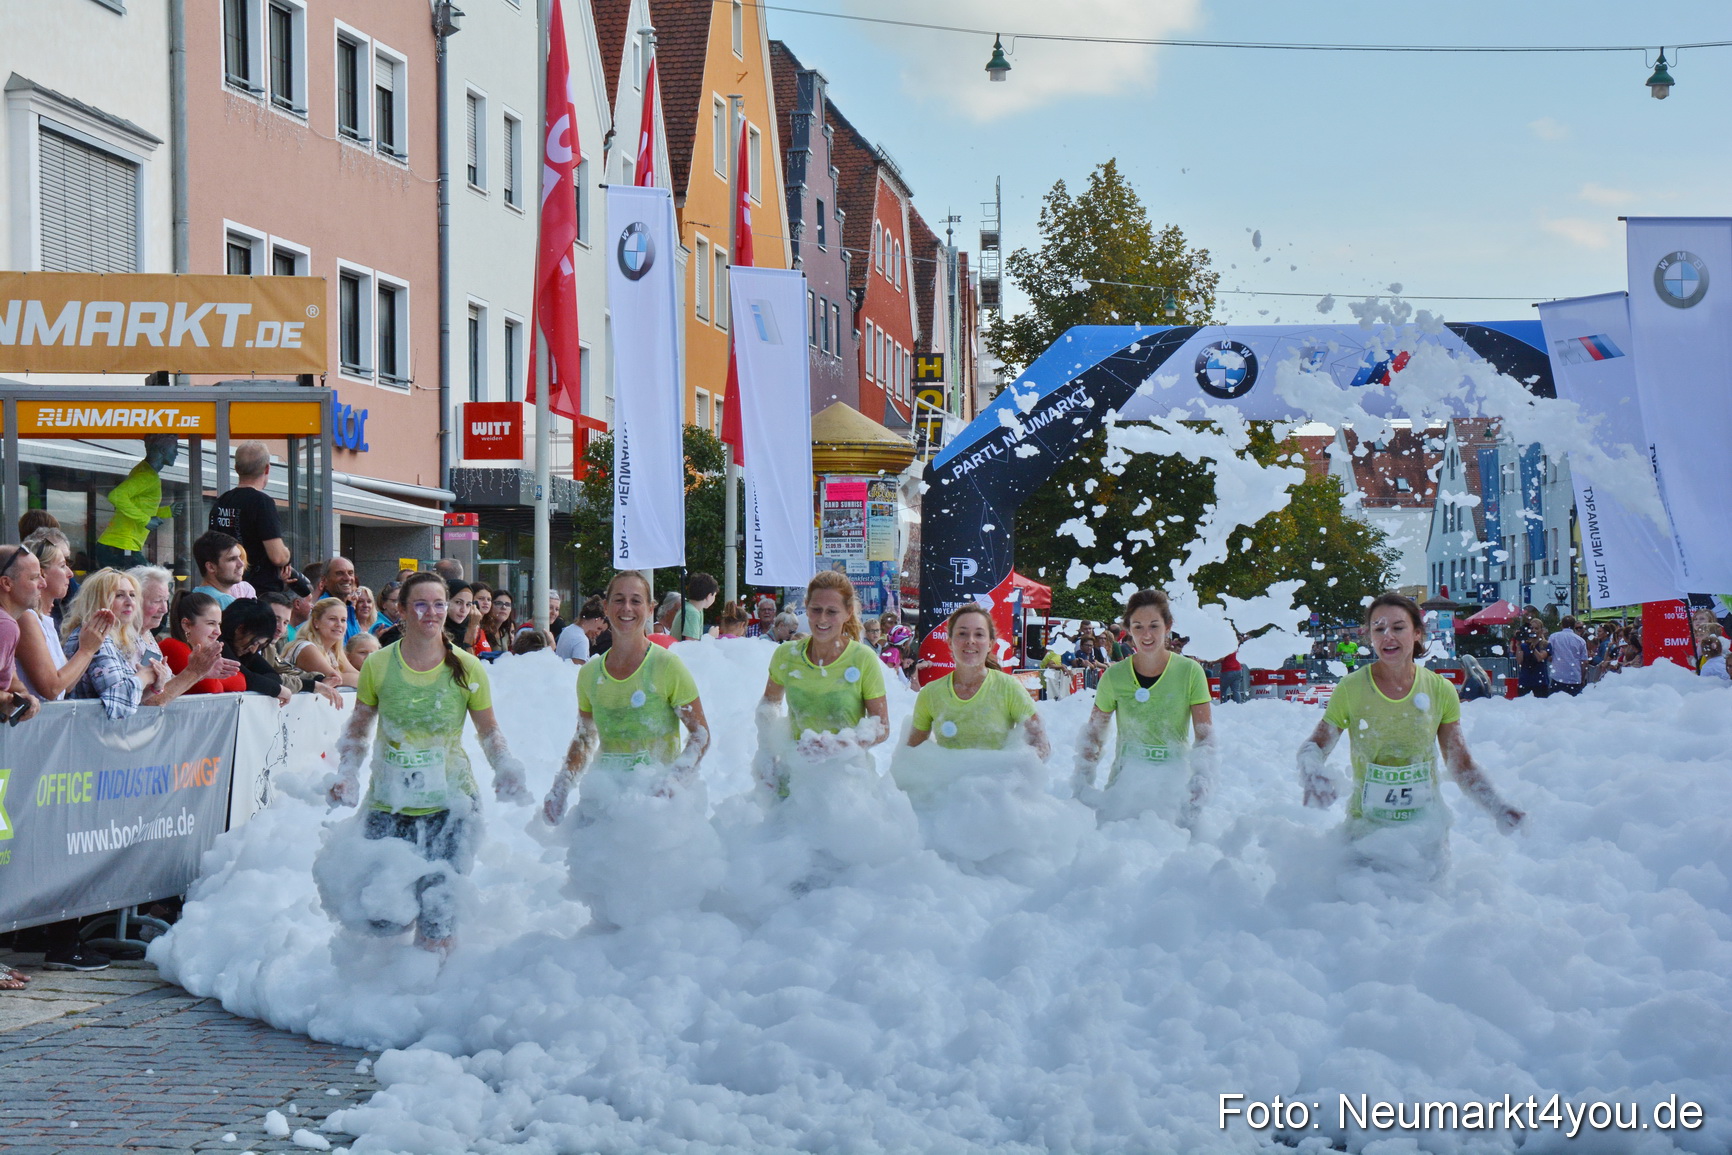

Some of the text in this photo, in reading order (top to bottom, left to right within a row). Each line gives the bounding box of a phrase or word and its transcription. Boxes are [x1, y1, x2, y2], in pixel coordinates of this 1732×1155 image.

[36, 408, 200, 427] RUNMARKT.DE
[471, 421, 511, 436] WITT
[952, 442, 1004, 480] PARTL
[1664, 612, 1675, 620] 100
[1664, 637, 1689, 646] BMW
[37, 771, 93, 807] OFFICE
[96, 764, 171, 800] INDUSTRY
[1385, 787, 1414, 806] 45
